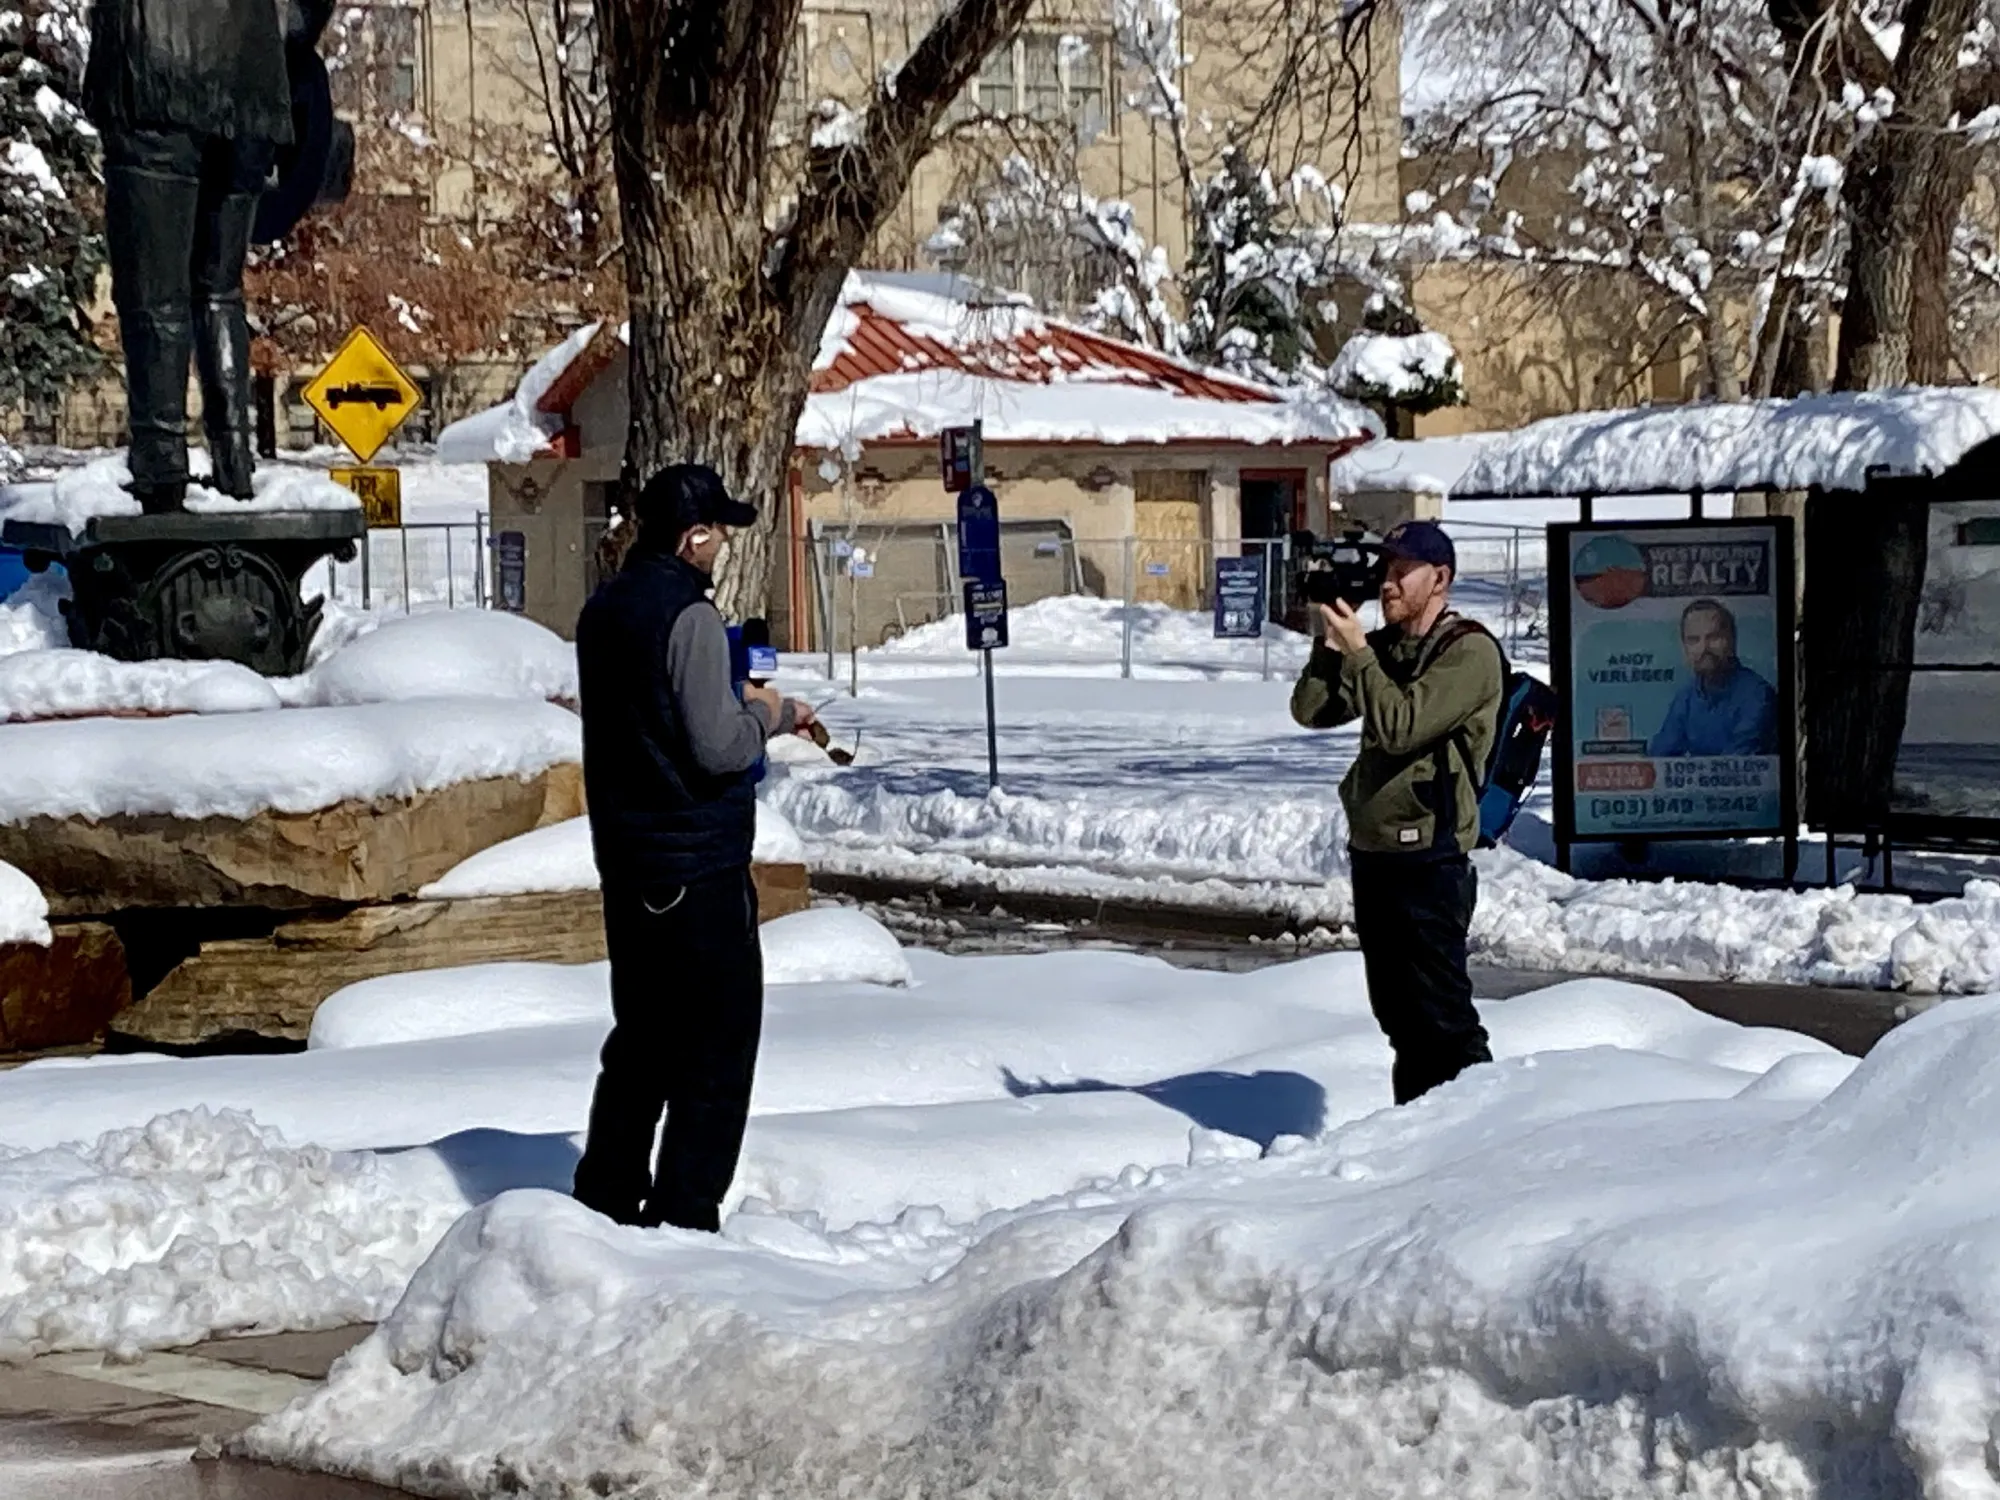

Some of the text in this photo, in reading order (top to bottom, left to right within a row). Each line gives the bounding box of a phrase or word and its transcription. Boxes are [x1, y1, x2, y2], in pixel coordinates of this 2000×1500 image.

[1652, 560, 1761, 585] REALTY
[1606, 653, 1654, 666] ANDY
[1591, 798, 1647, 819] (303)
